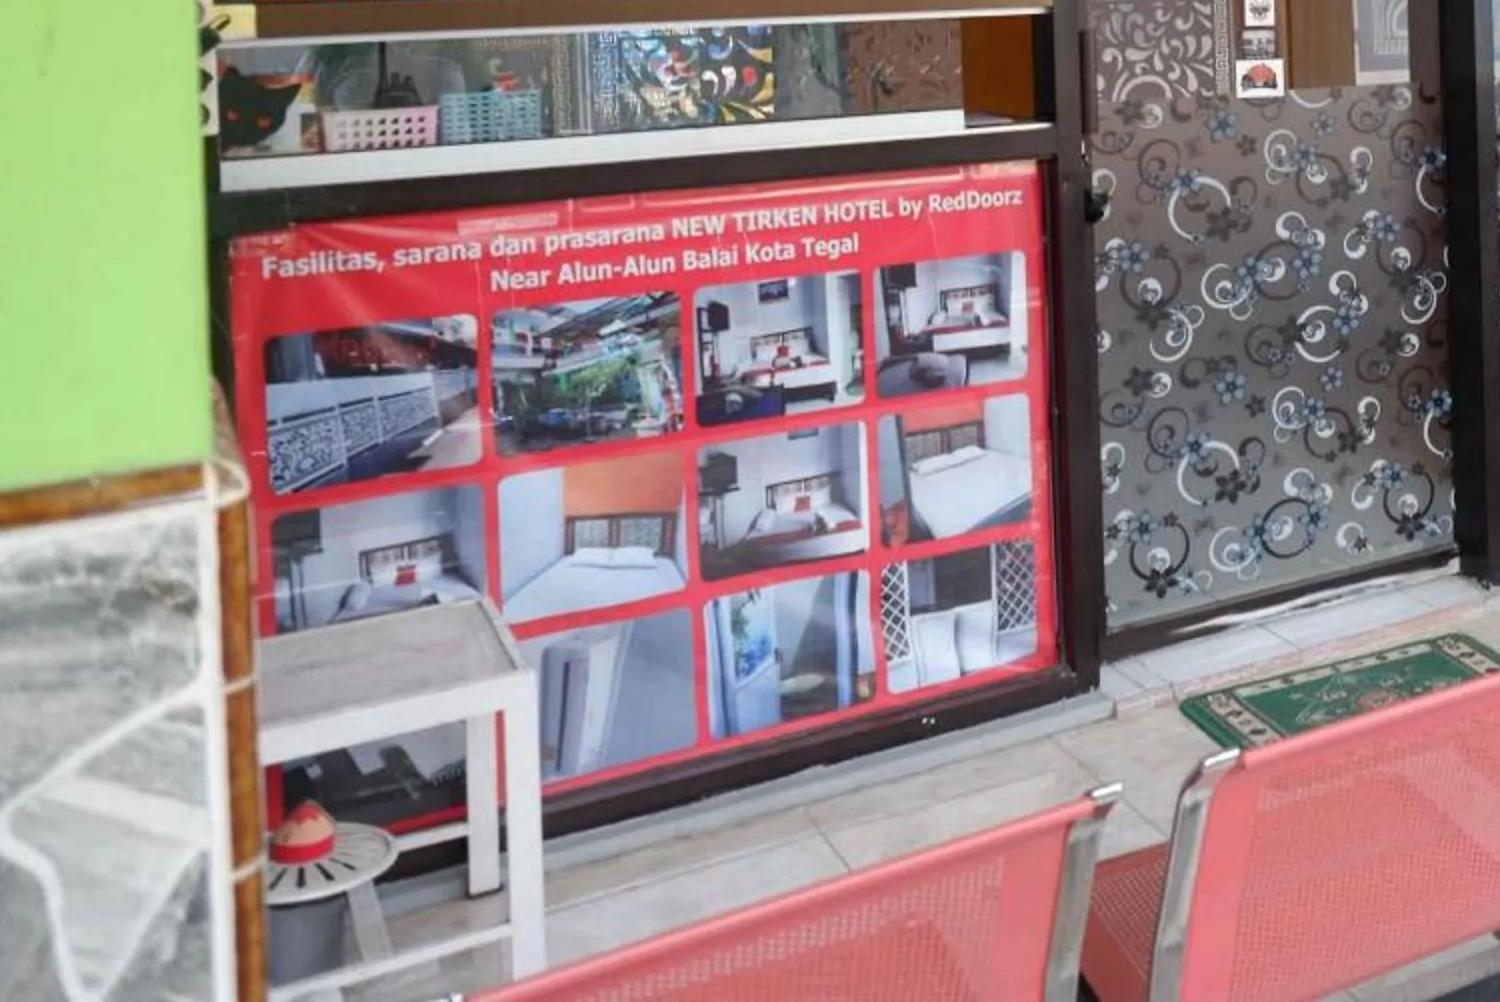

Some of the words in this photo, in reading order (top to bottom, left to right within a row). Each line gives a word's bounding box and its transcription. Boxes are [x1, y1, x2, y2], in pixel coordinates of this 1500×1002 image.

[261, 247, 385, 280] Fasilitas,
[392, 239, 483, 268] sarana
[489, 234, 537, 258] dan
[545, 221, 664, 255] prasarana
[671, 214, 727, 236] NEW
[732, 207, 817, 233] TIRKEN
[823, 198, 894, 224] HOTEL
[898, 196, 922, 223] by
[928, 187, 1024, 214] RedDoorz
[490, 269, 552, 293] Near
[557, 249, 676, 285] Alun-Alun
[682, 244, 739, 271] Balai
[745, 239, 797, 264] Kota
[800, 232, 860, 263] Tegal
